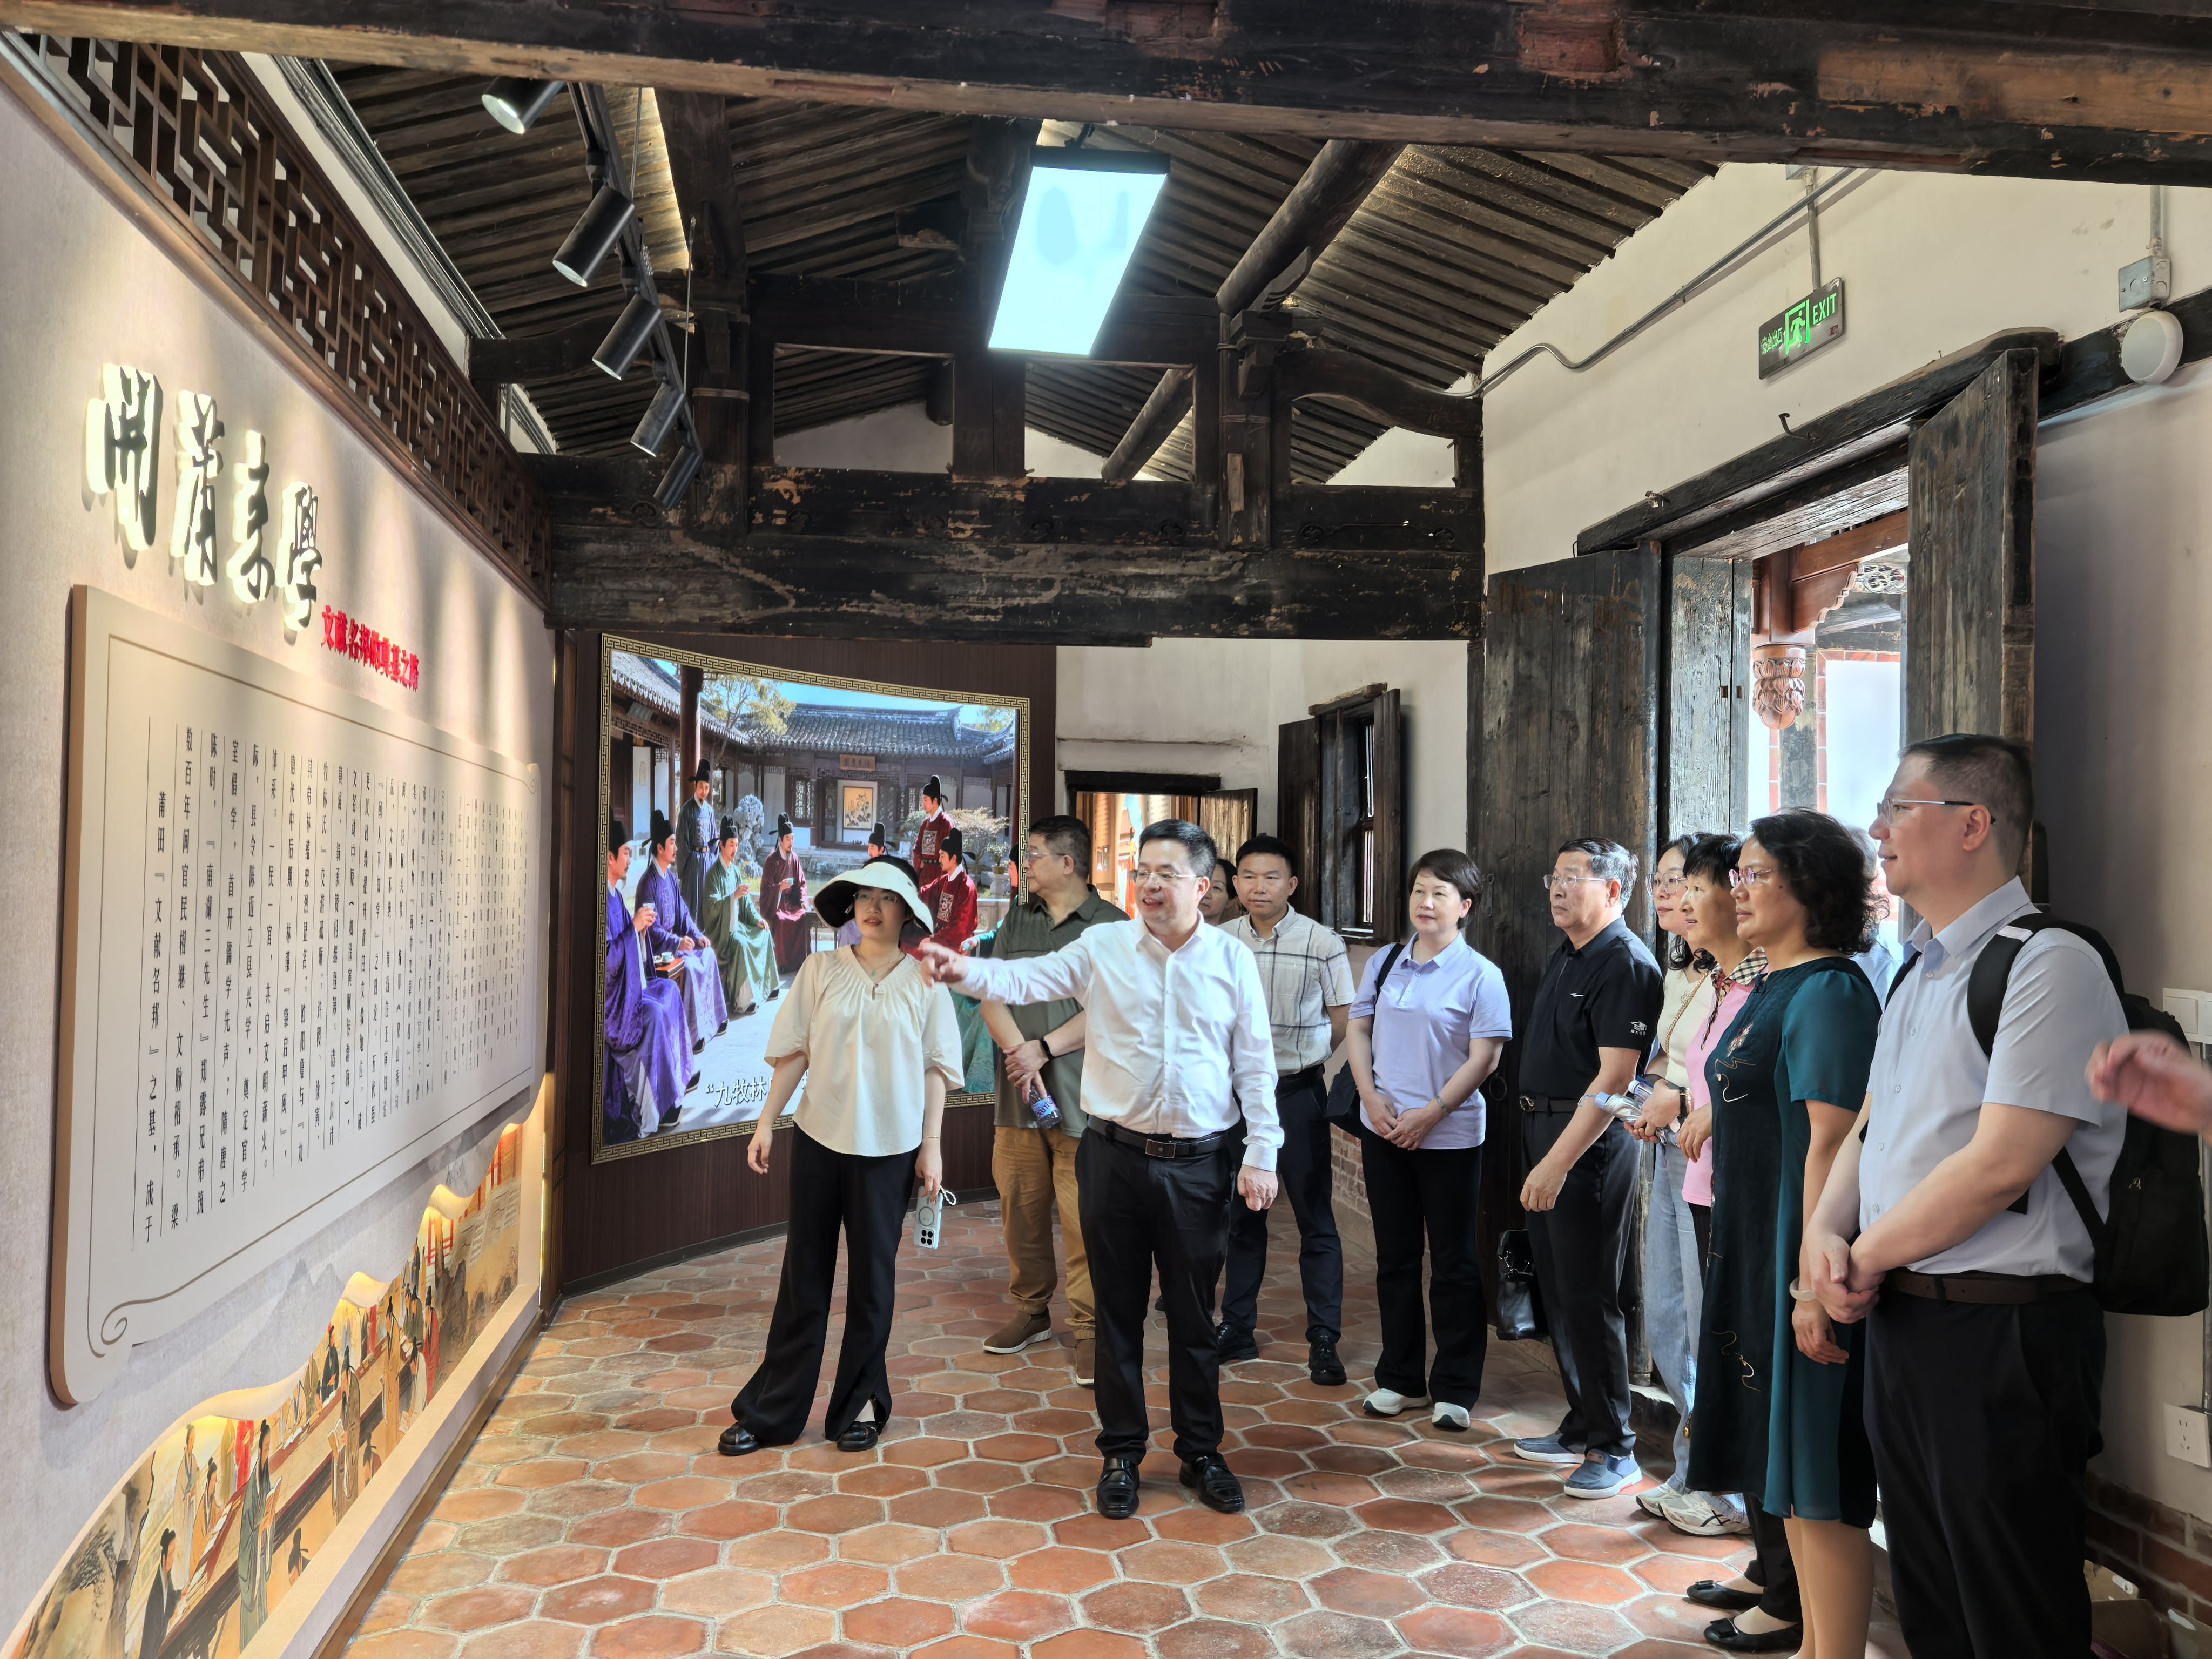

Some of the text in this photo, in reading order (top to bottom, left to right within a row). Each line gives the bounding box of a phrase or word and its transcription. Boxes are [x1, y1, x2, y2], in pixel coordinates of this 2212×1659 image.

[1813, 293, 1837, 325] EXIT
[1762, 327, 1783, 355] 安全出口
